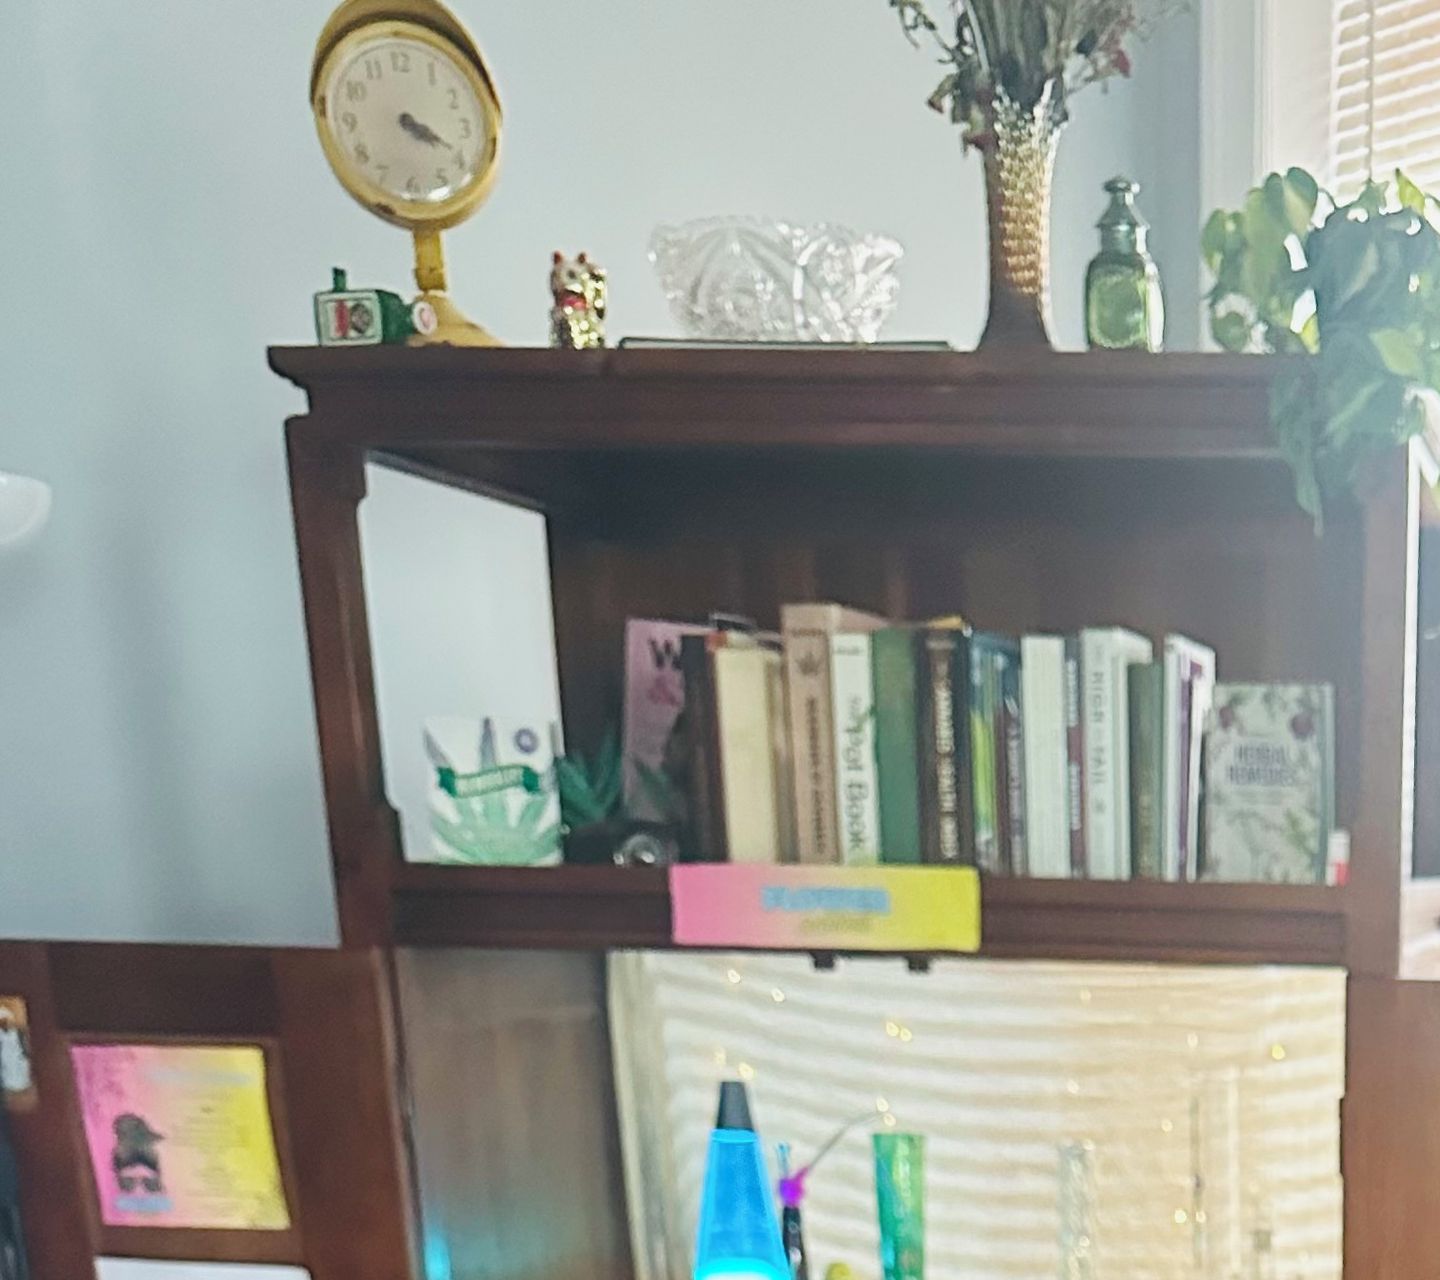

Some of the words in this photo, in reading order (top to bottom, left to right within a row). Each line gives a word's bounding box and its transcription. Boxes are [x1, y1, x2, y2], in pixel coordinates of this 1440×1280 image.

[365, 59, 383, 80] 11
[390, 51, 410, 73] 12
[427, 62, 436, 86] 1
[346, 80, 367, 102] 10
[447, 89, 459, 110] 2
[342, 112, 357, 133] 9
[459, 117, 471, 139] 3
[354, 143, 370, 164] 8
[376, 164, 390, 186] 7
[406, 176, 421, 193] 6
[436, 168, 449, 187] 5
